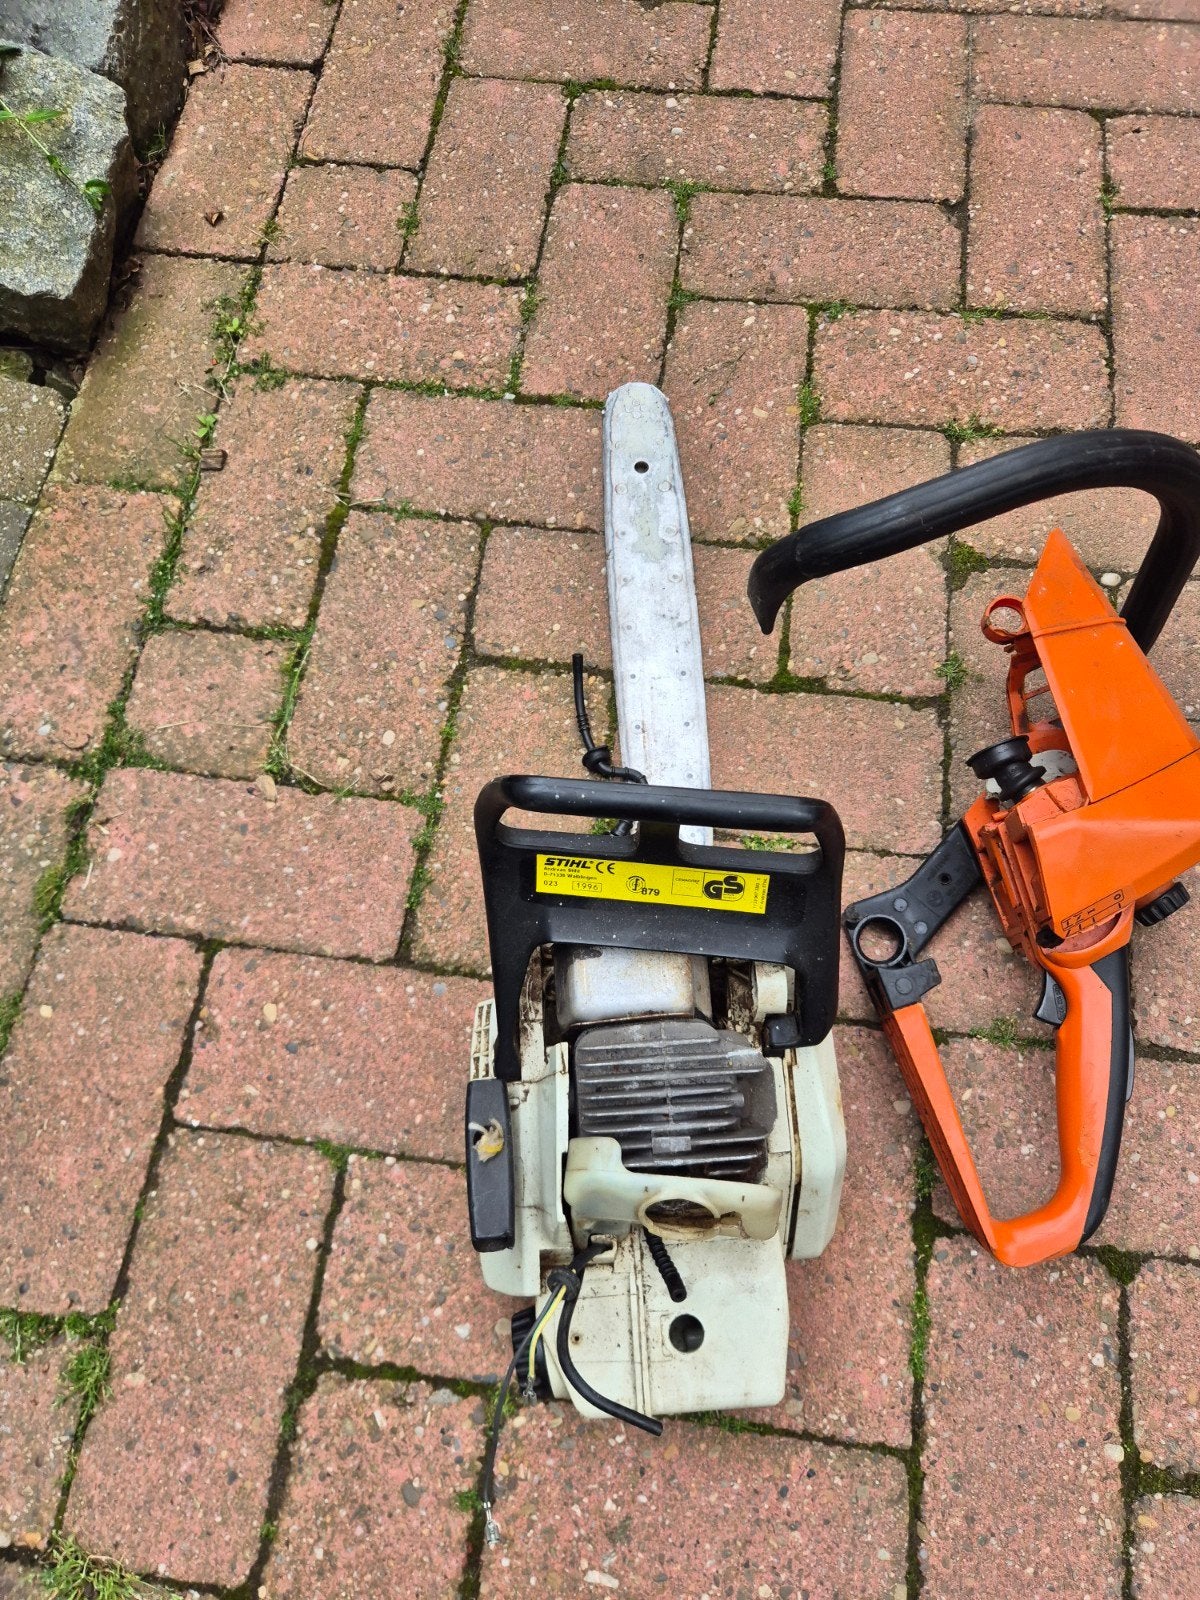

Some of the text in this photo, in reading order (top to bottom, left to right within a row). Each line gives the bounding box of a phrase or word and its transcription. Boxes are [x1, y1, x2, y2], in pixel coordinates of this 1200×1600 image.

[544, 857, 591, 869] STIHL
[577, 882, 599, 891] 1996
[641, 887, 660, 897] 879
[704, 875, 744, 901] GS
